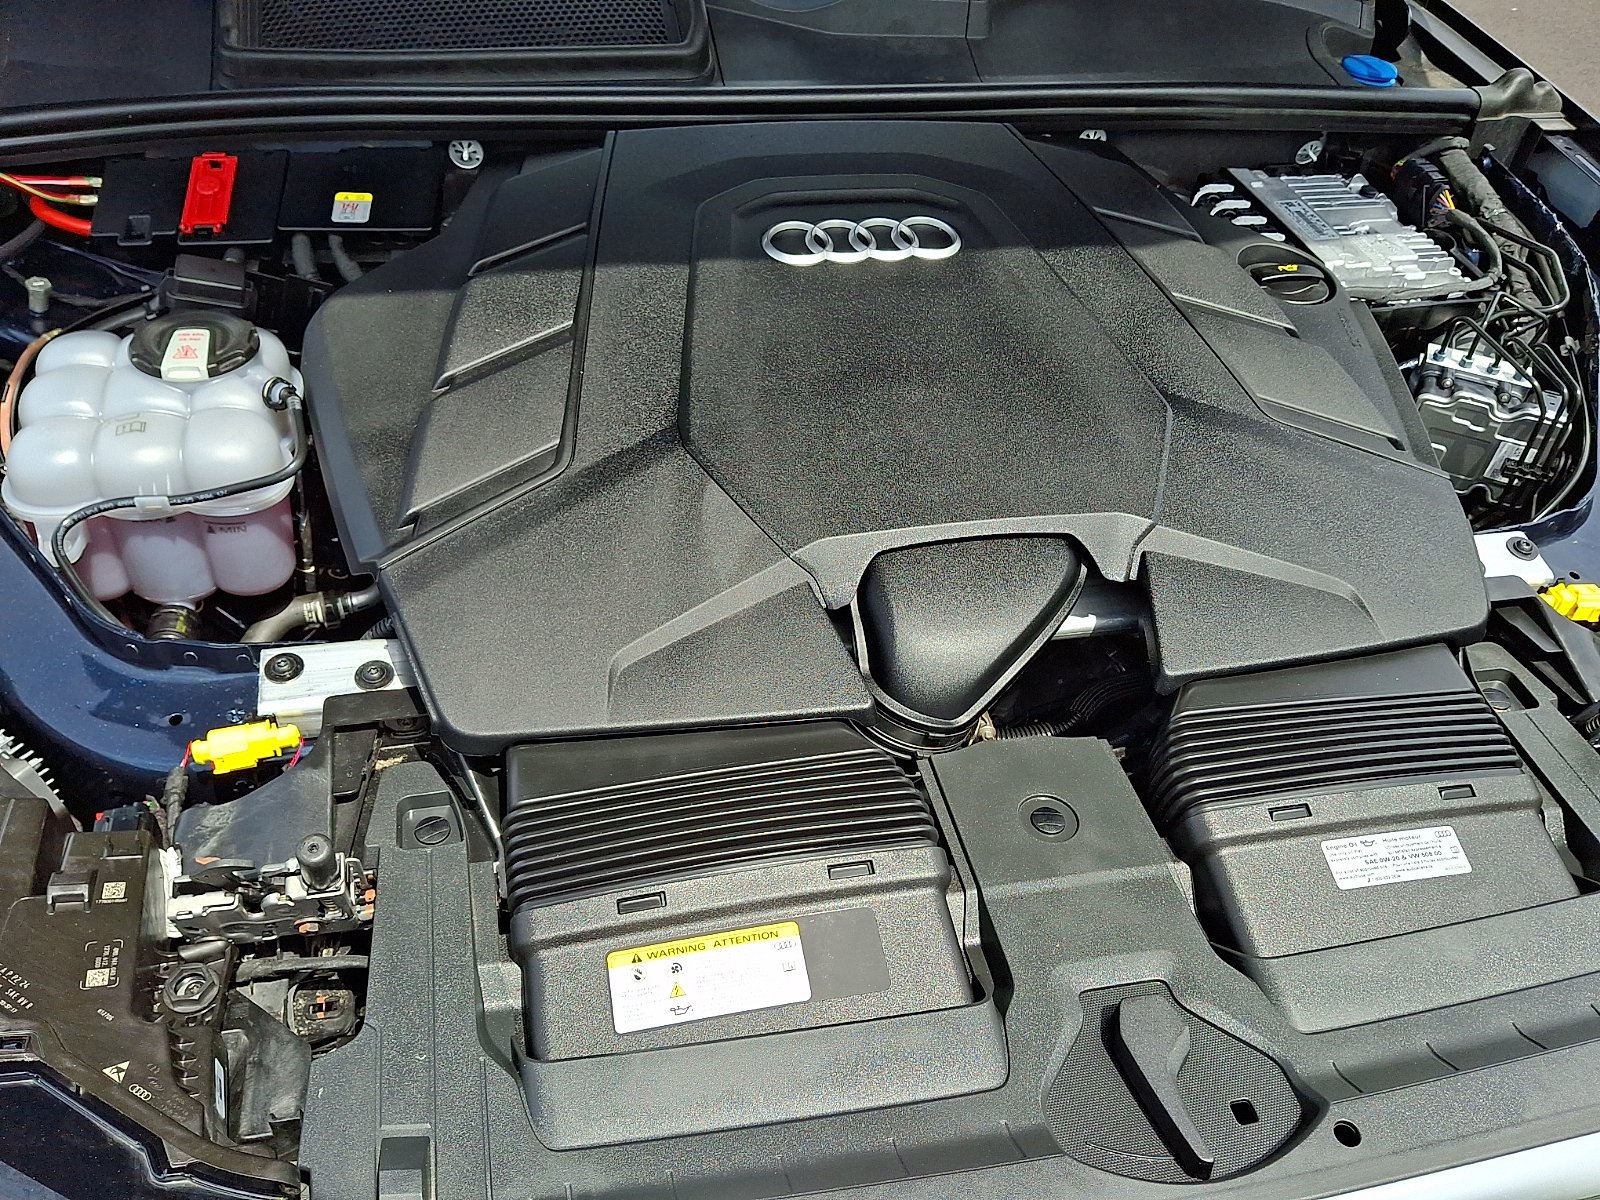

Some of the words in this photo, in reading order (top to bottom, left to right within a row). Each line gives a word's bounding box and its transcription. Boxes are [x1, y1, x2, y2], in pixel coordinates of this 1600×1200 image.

[646, 942, 706, 959] WARNING
[713, 930, 779, 948] ATTENTION
[5, 988, 20, 999] SAE
